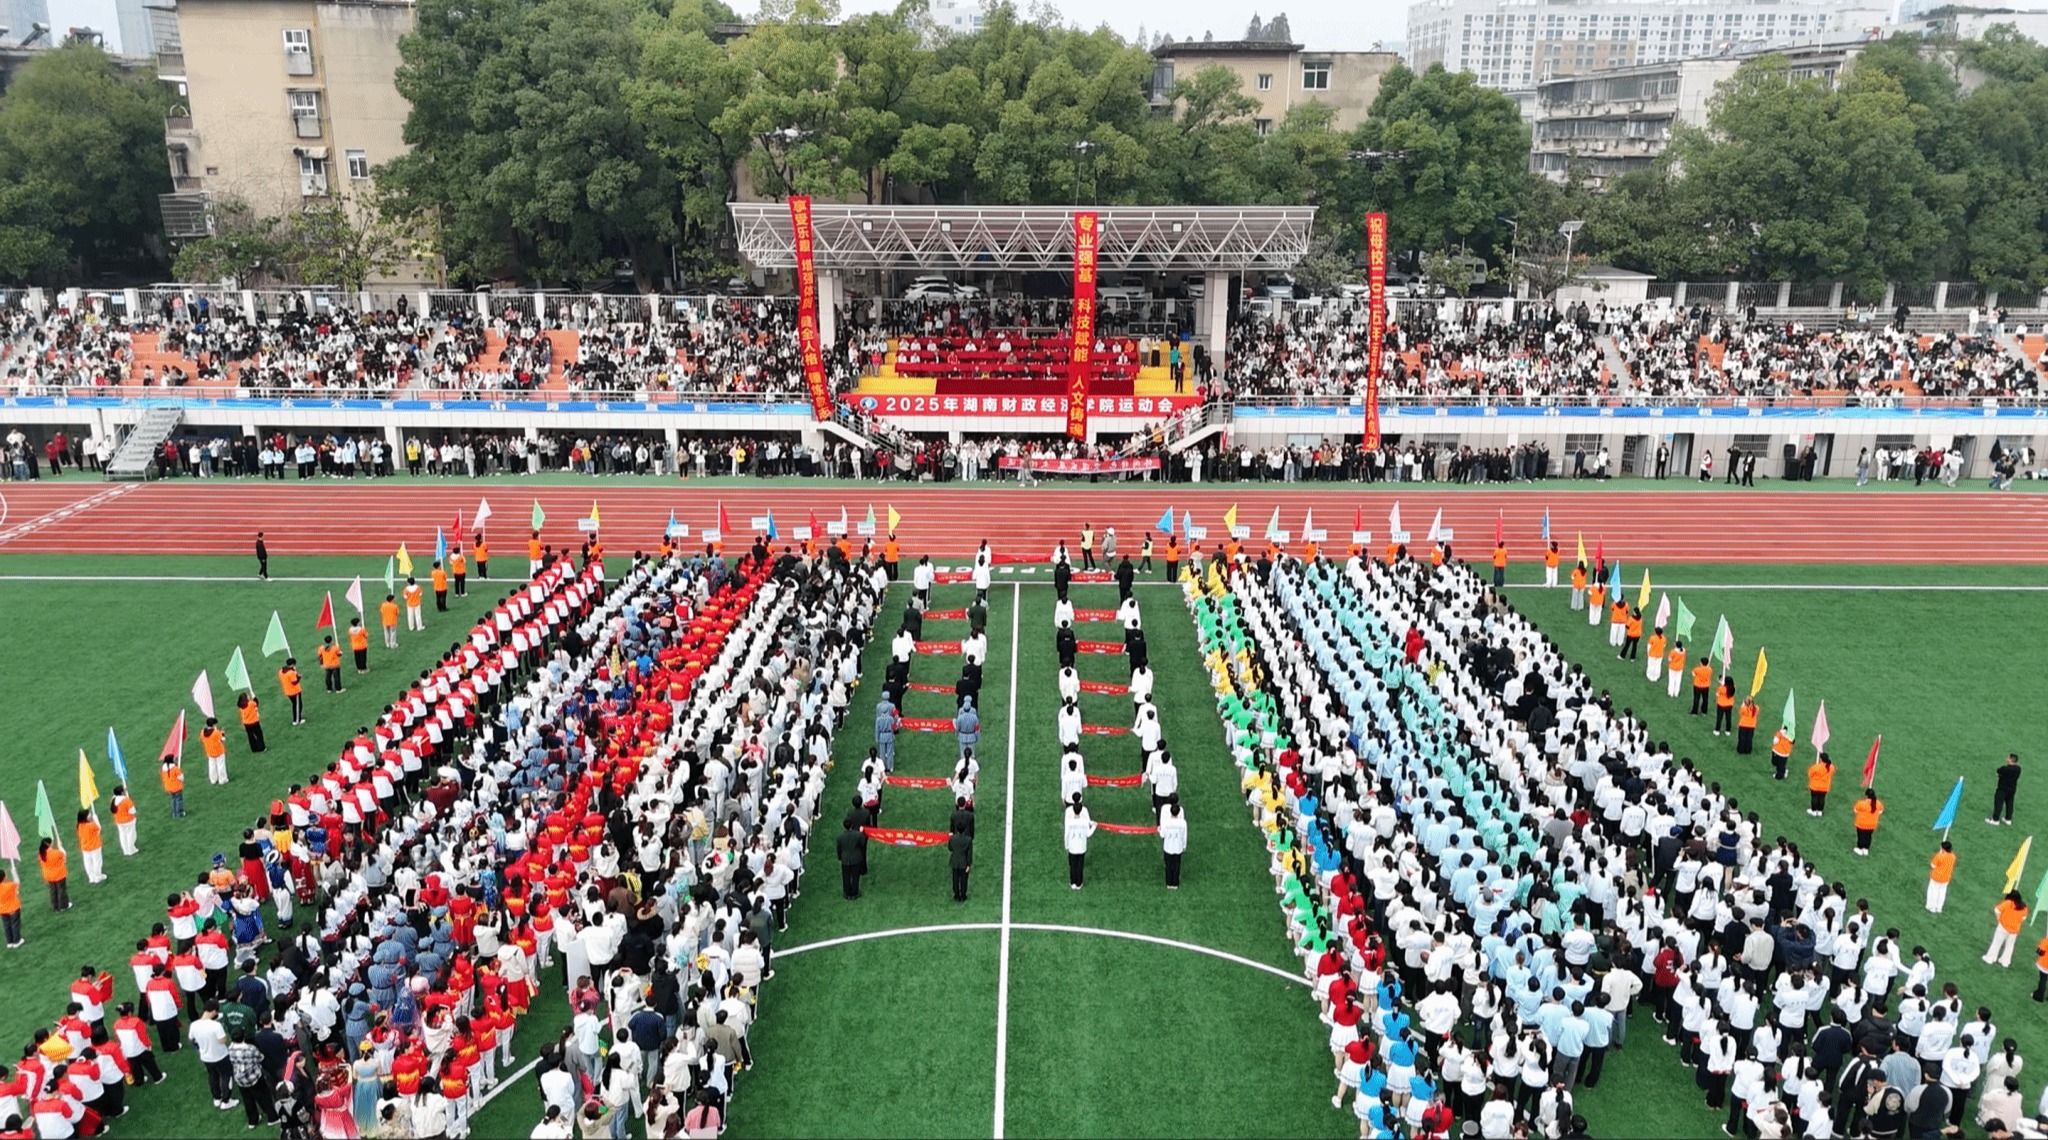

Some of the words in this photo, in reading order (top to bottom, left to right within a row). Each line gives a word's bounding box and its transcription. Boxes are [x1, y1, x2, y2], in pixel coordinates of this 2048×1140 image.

[1077, 215, 1094, 283] 专业强基
[1073, 298, 1092, 362] 科技赋能
[1069, 376, 1085, 437] 人文铸魂
